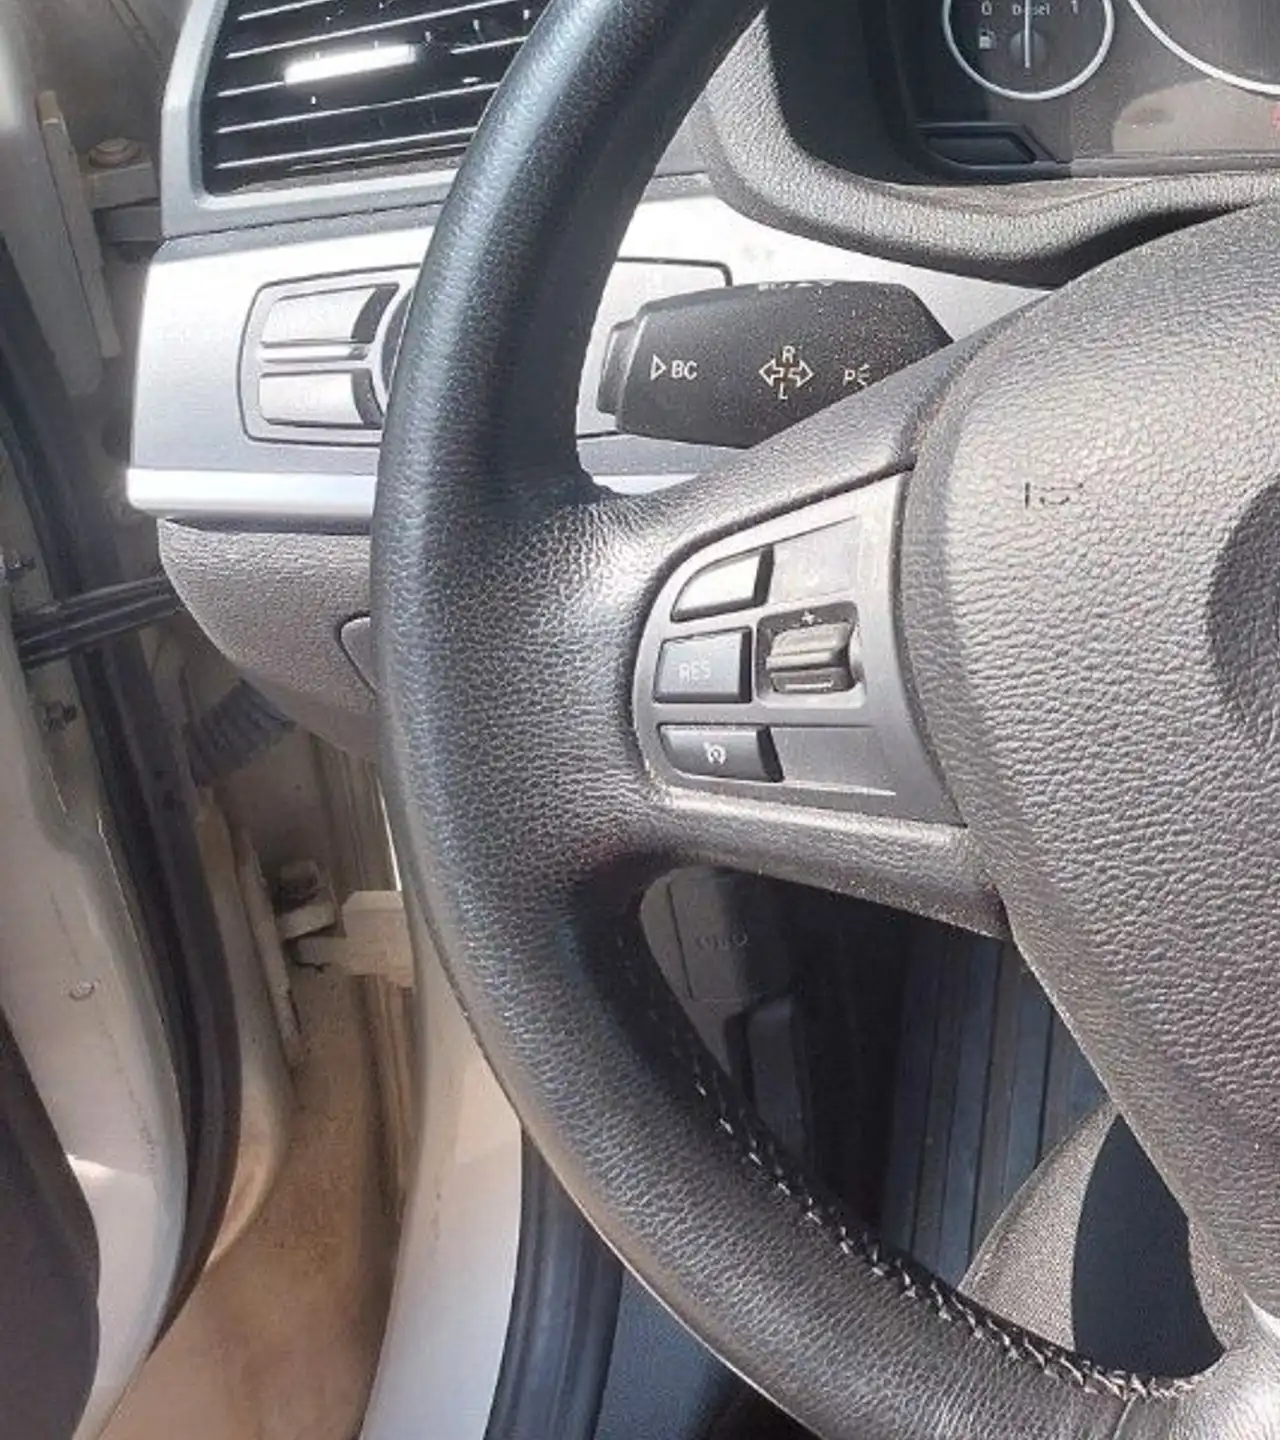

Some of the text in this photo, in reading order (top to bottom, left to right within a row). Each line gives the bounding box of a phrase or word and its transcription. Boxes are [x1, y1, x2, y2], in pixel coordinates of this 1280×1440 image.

[981, 0, 993, 16] 0
[1070, 0, 1079, 15] 1
[781, 345, 796, 363] R
[671, 359, 698, 380] BC
[842, 368, 856, 386] P
[678, 660, 711, 681] RES
